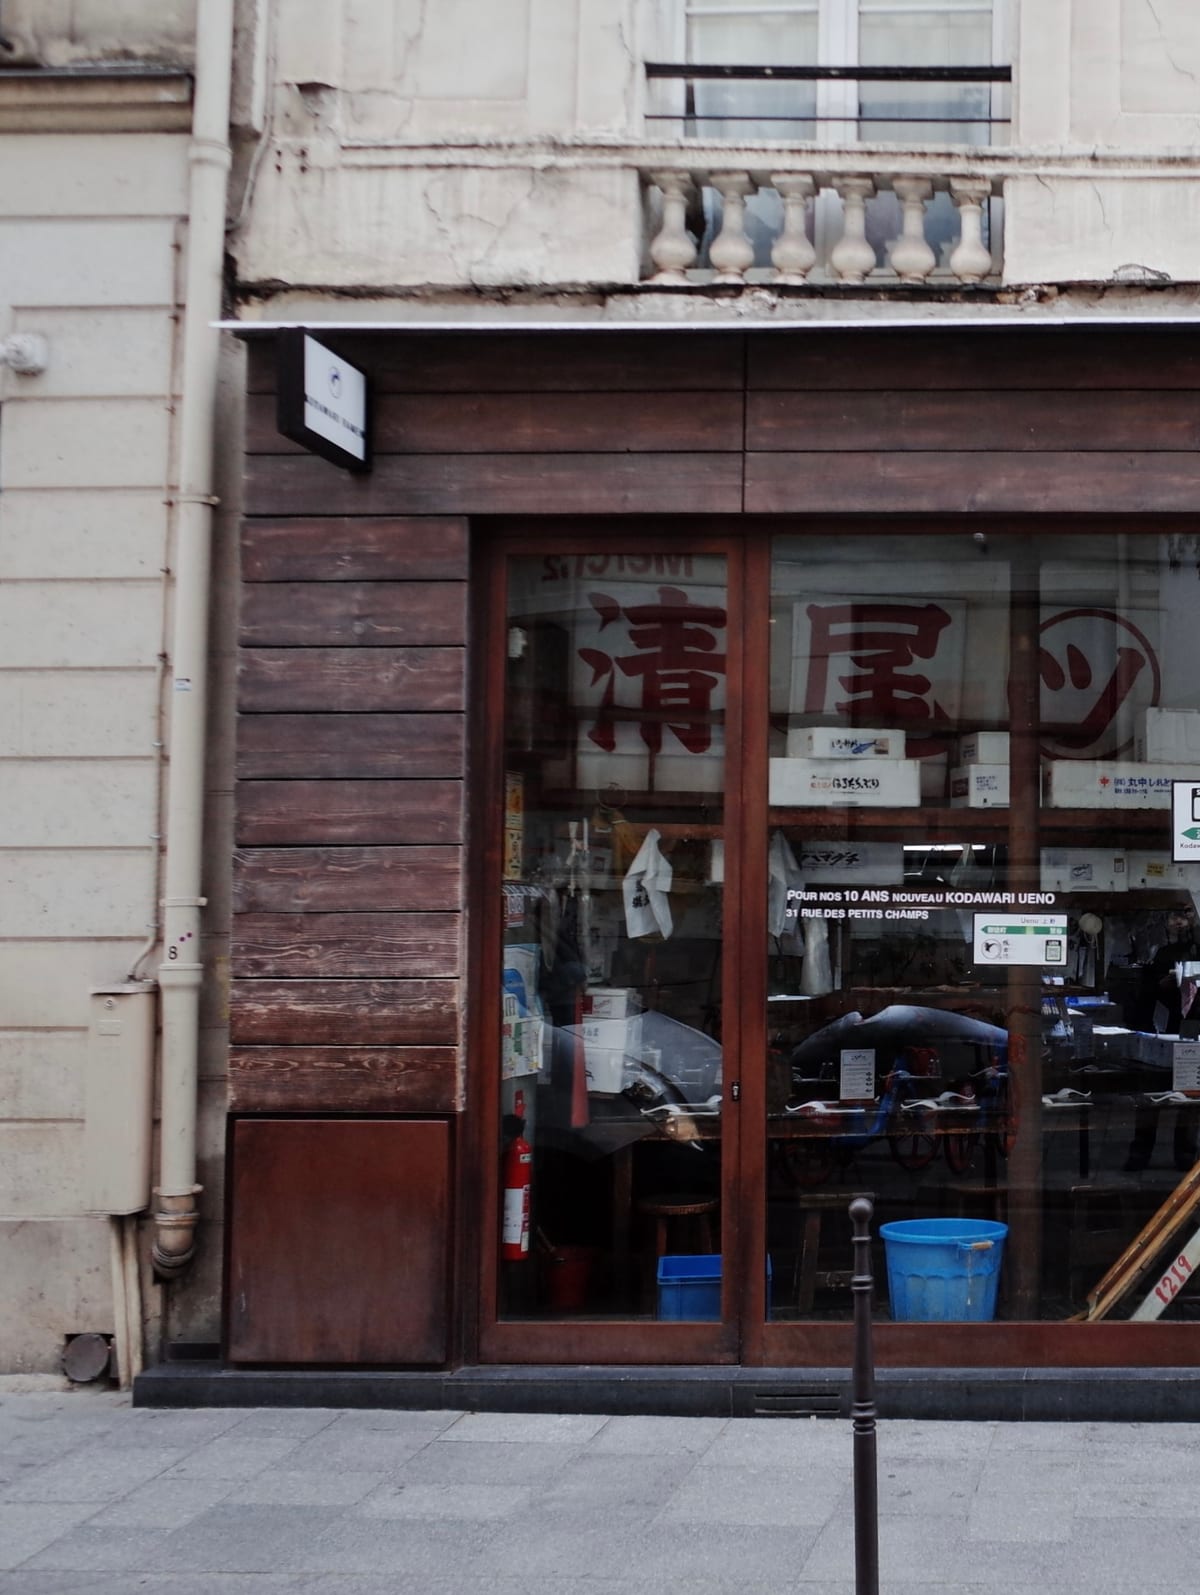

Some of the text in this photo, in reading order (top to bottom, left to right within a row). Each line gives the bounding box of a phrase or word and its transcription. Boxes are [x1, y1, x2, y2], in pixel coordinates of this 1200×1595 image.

[786, 890, 1056, 905] POUR NOS 10 ANS NOUVEAU KODAWARI UENO
[785, 908, 929, 920] 31 RUE DES PETITS CHAMPS
[168, 946, 178, 960] 8
[1153, 1254, 1194, 1305] 1219
